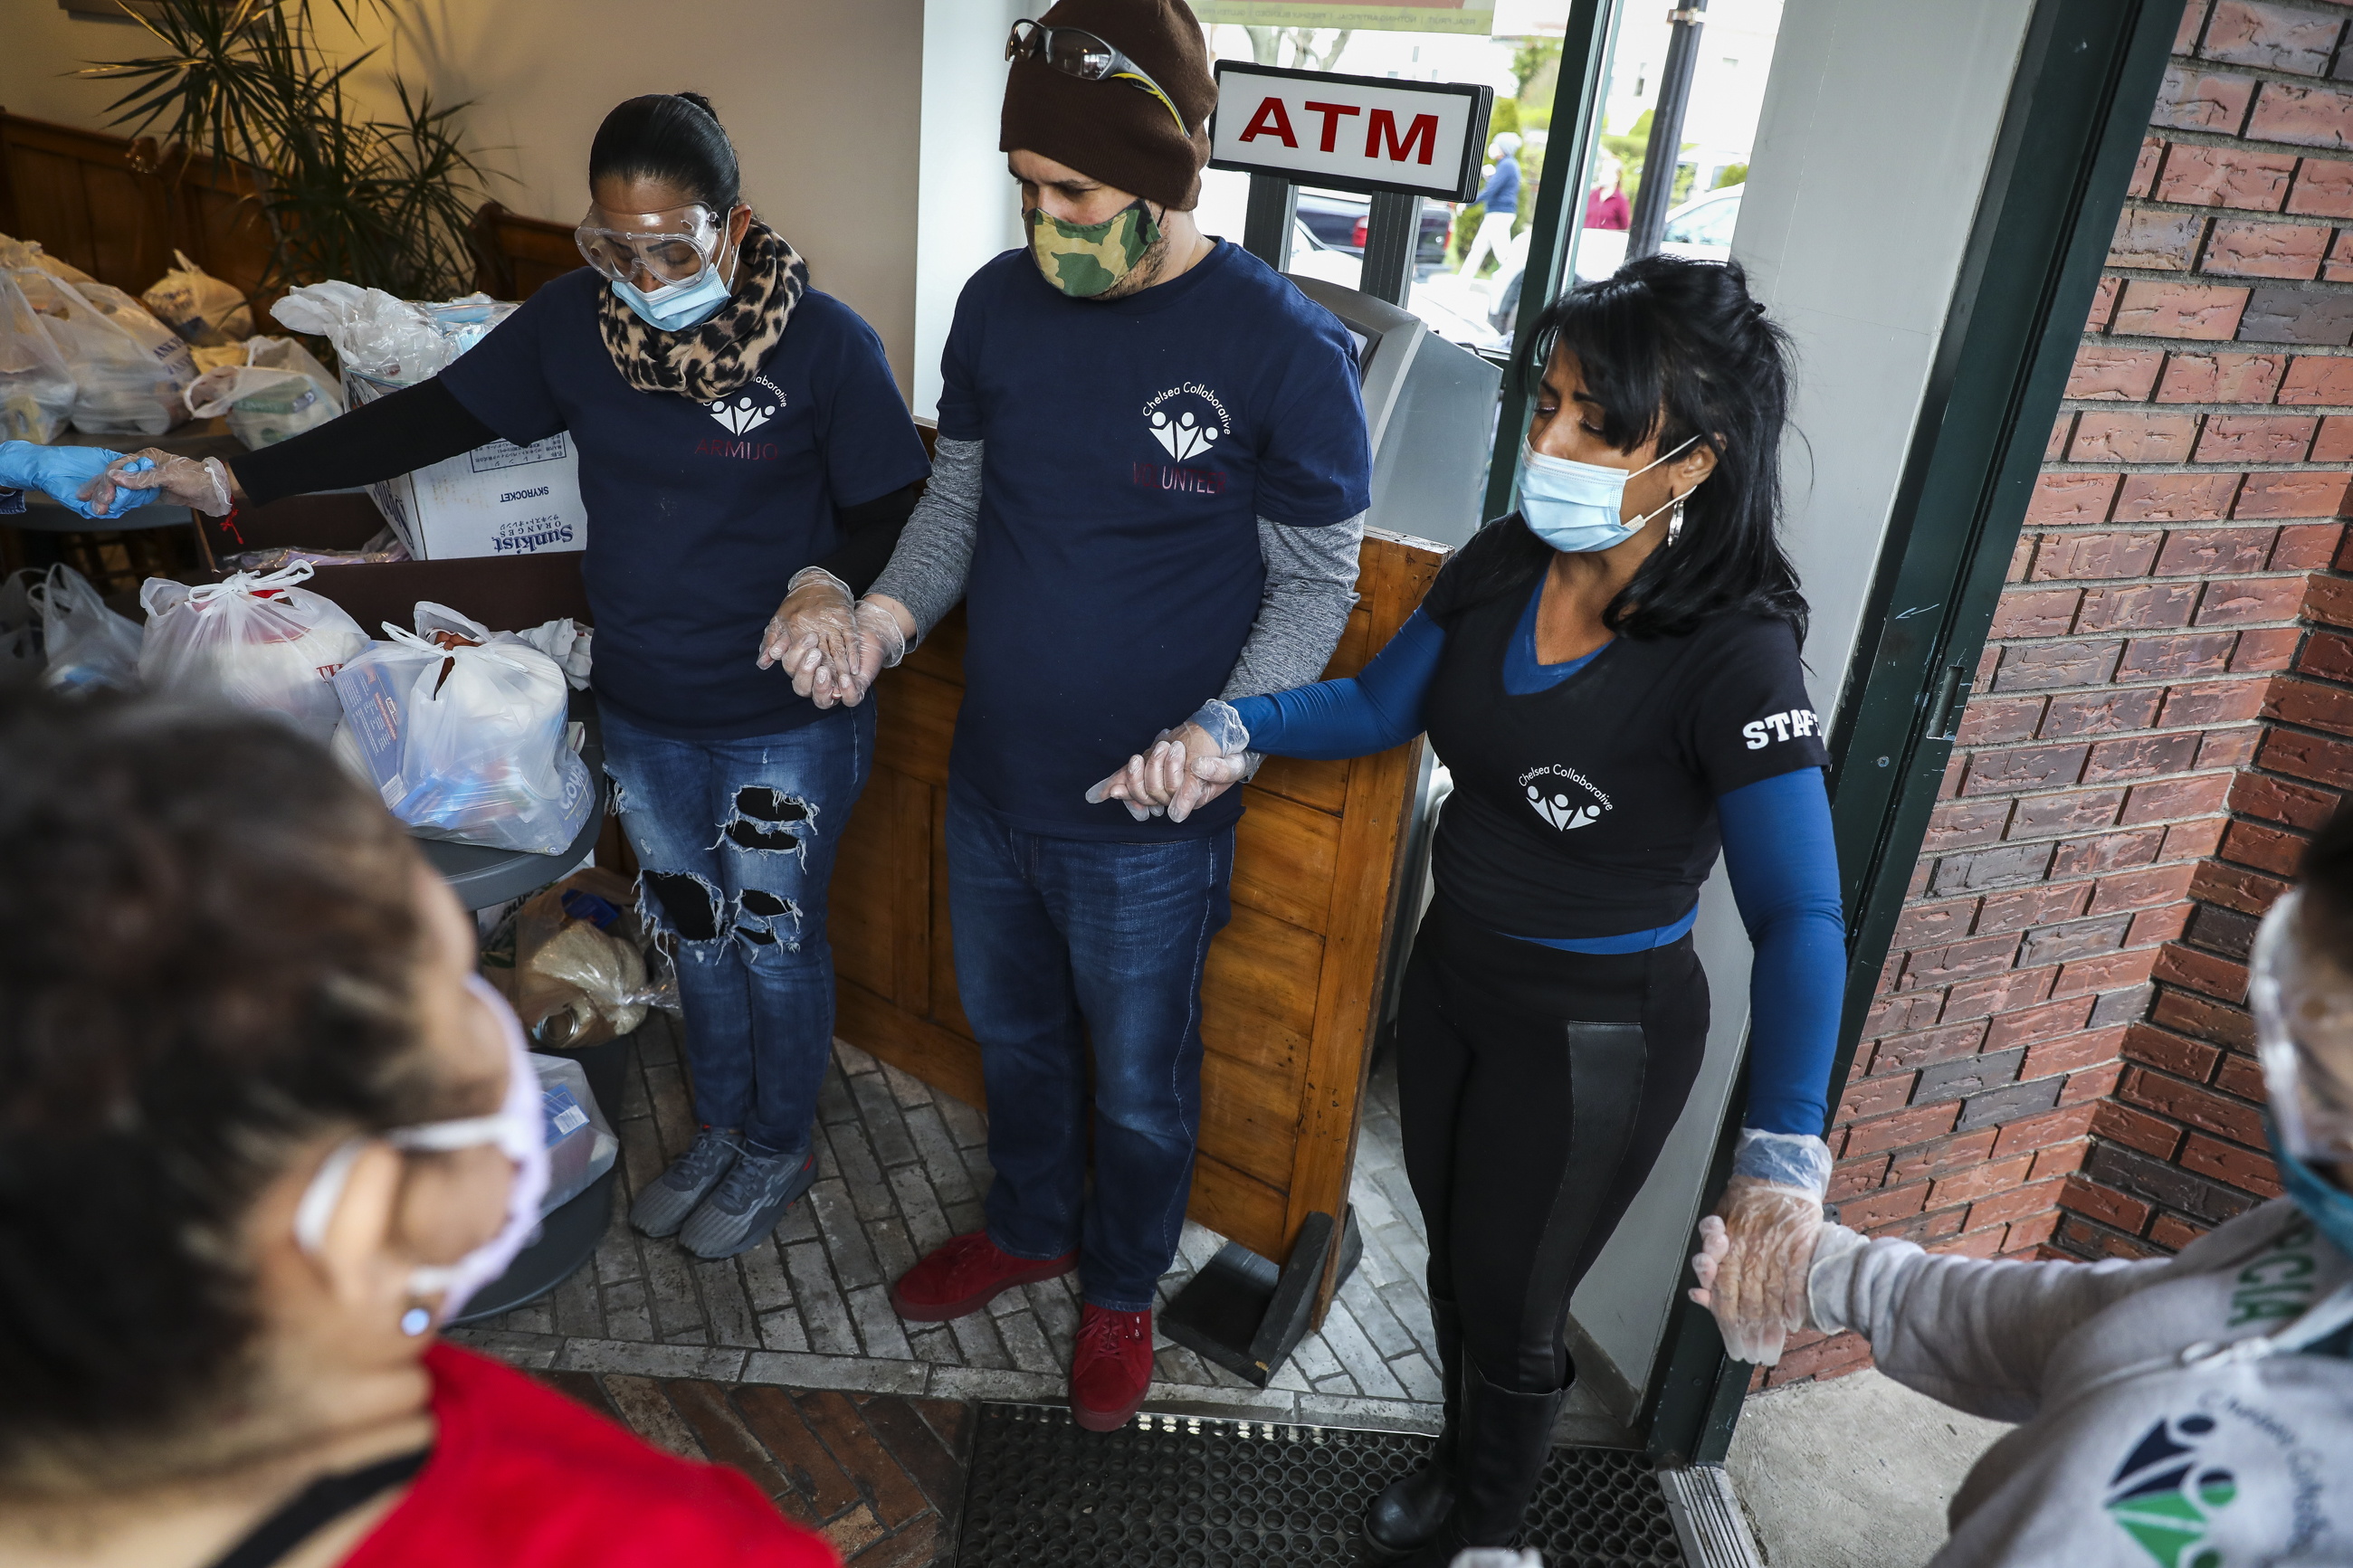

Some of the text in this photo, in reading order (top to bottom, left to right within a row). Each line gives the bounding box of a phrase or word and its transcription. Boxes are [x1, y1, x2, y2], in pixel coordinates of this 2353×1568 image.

[1238, 96, 1439, 166] ATM
[752, 375, 787, 408] aborative
[1142, 381, 1232, 435] Chelsea Collaborative
[694, 438, 778, 461] ARMIJO
[1133, 461, 1226, 494] VOLUNTEER
[500, 486, 549, 503] SKYROCKET
[491, 523, 574, 555] Sunkist
[500, 520, 561, 537] ORANGES
[1519, 763, 1614, 812] Chelsea Collaborative
